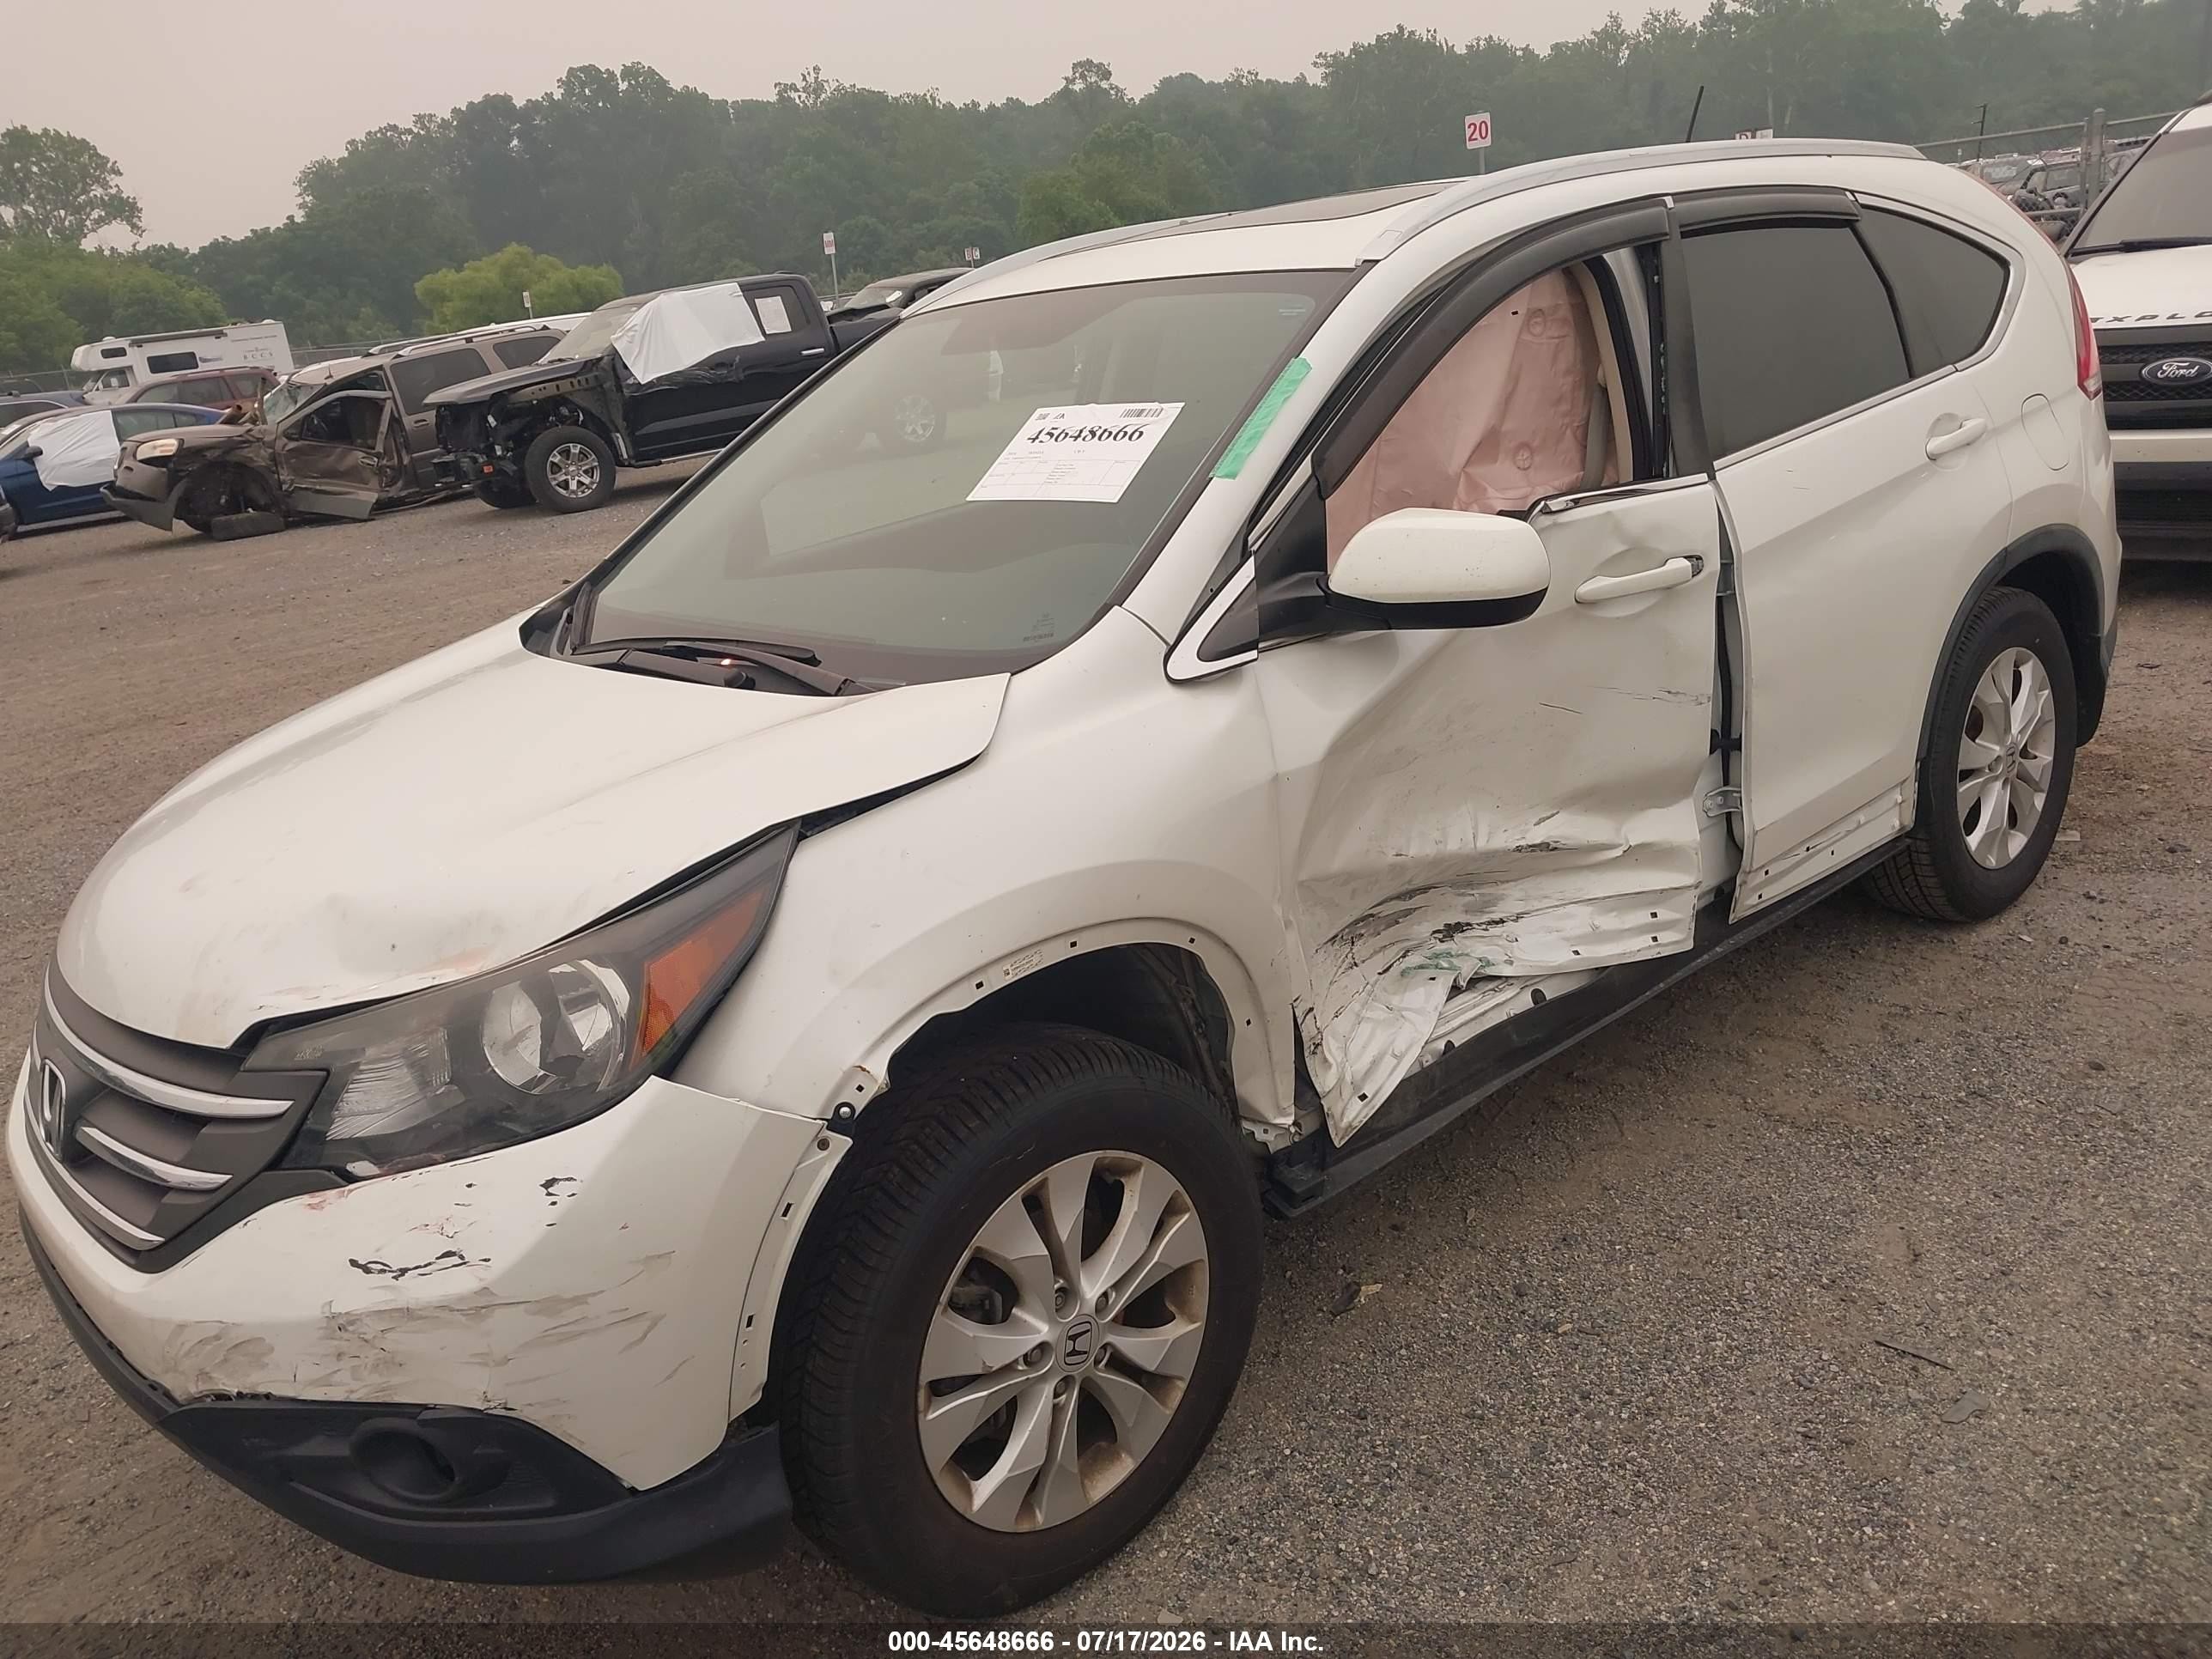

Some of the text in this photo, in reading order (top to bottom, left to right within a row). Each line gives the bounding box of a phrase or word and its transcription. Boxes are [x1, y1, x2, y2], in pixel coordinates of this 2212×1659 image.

[1468, 120, 1489, 142] 20
[2157, 362, 2200, 379] Ford
[1027, 423, 1150, 444] 45648666
